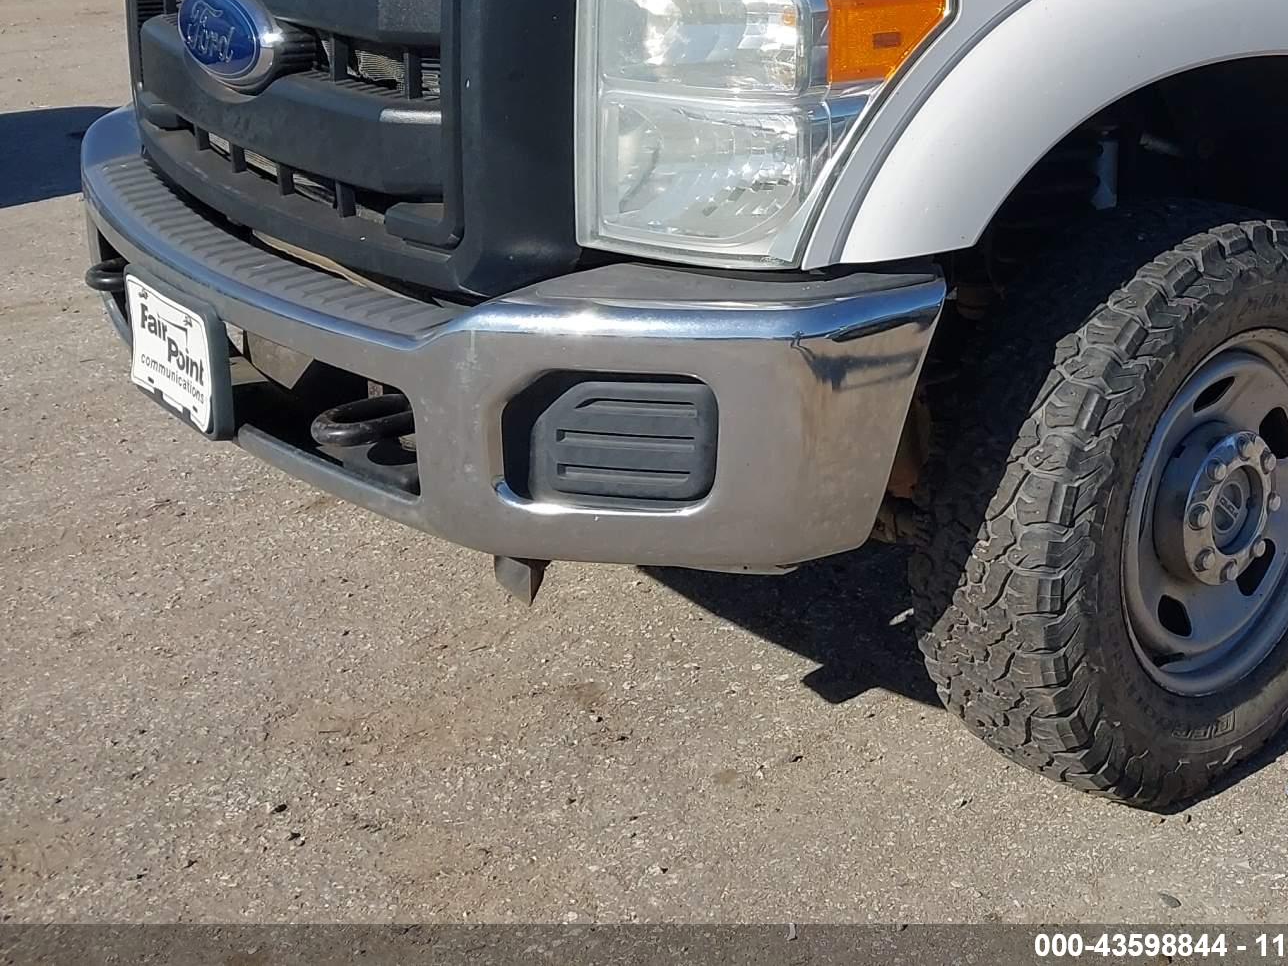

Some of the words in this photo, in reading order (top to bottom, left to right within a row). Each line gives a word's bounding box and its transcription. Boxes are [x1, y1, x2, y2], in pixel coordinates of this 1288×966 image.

[186, 0, 236, 64] Ford
[140, 302, 168, 342] Fair
[140, 353, 205, 404] communications
[167, 337, 205, 386] Point
